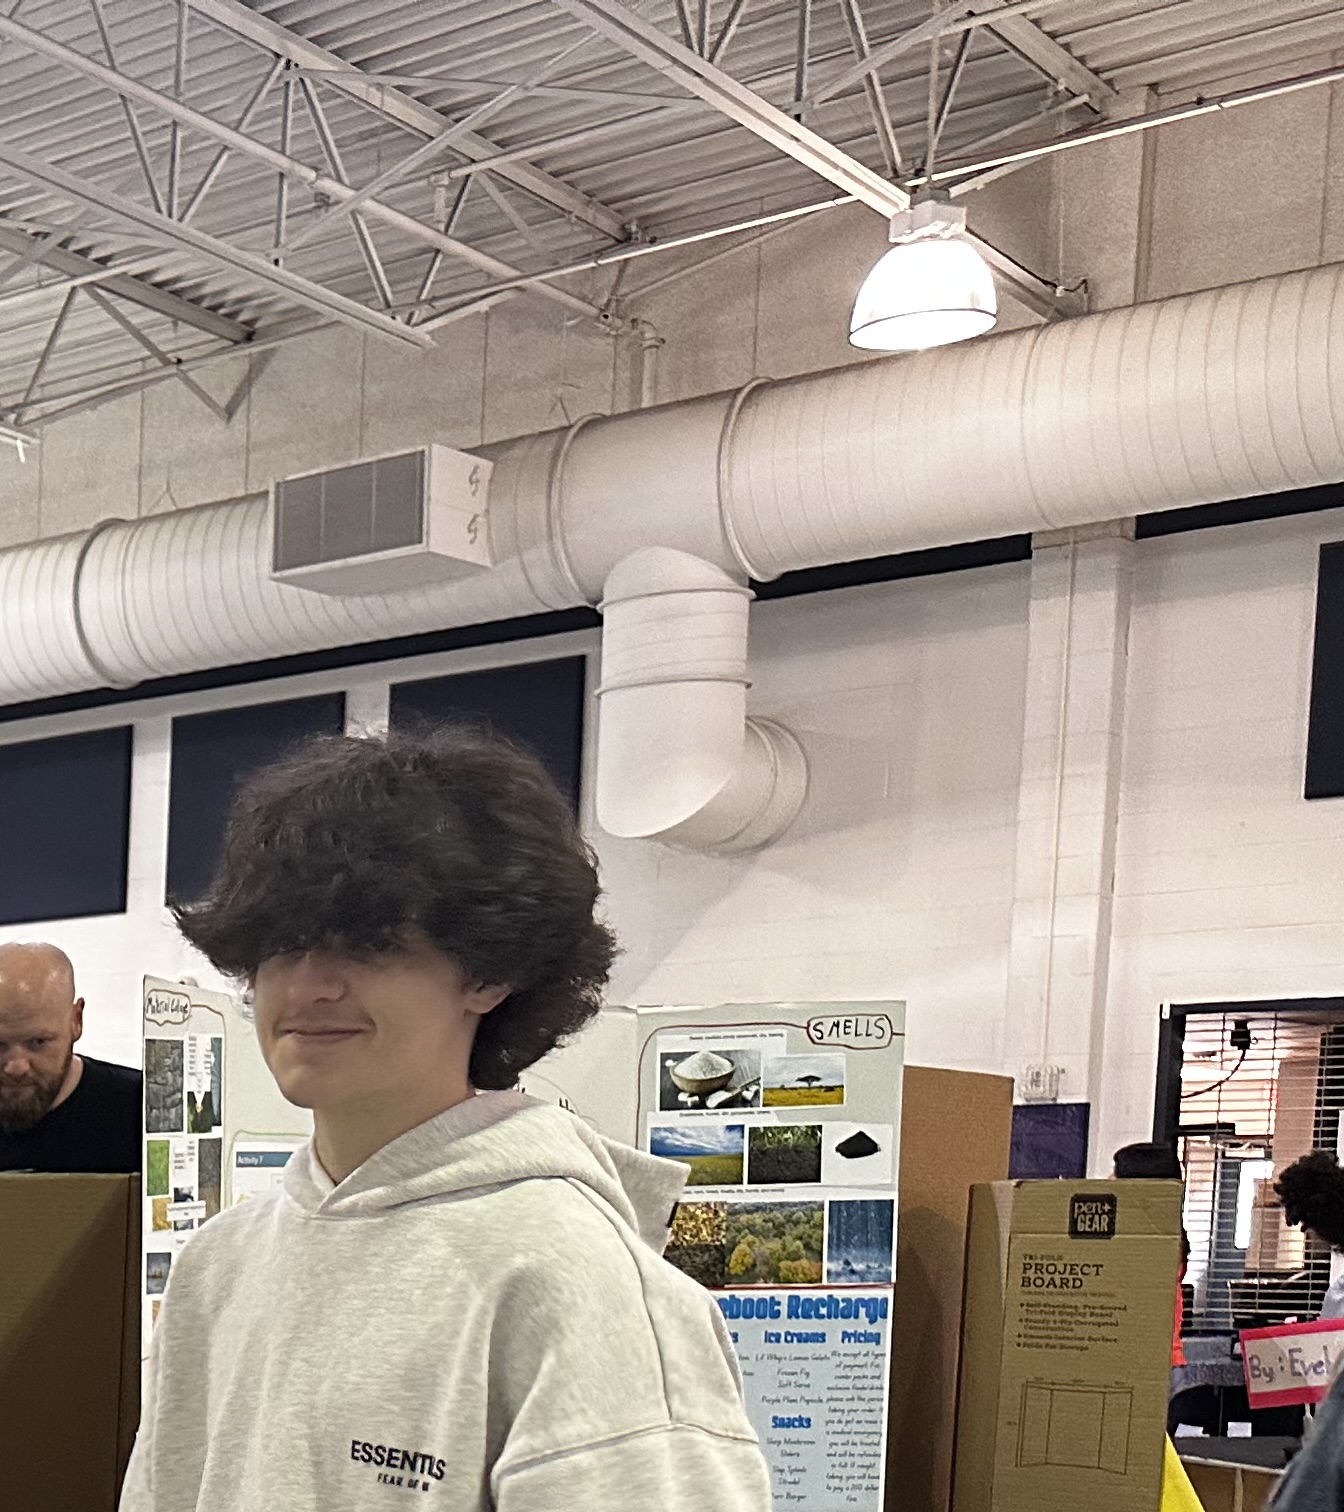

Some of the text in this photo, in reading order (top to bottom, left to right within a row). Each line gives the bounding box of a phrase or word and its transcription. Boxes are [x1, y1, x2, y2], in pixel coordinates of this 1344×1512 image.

[812, 1017, 886, 1040] SMELLS
[1073, 1201, 1111, 1219] pen+
[1077, 1214, 1109, 1232] GEAR
[1022, 1263, 1104, 1276] PROJECT
[1021, 1277, 1083, 1289] BOARD
[718, 1294, 781, 1319] eboot
[764, 1330, 826, 1344] Ice Creams
[841, 1330, 881, 1346] Pricing
[771, 1414, 811, 1429] Snacks
